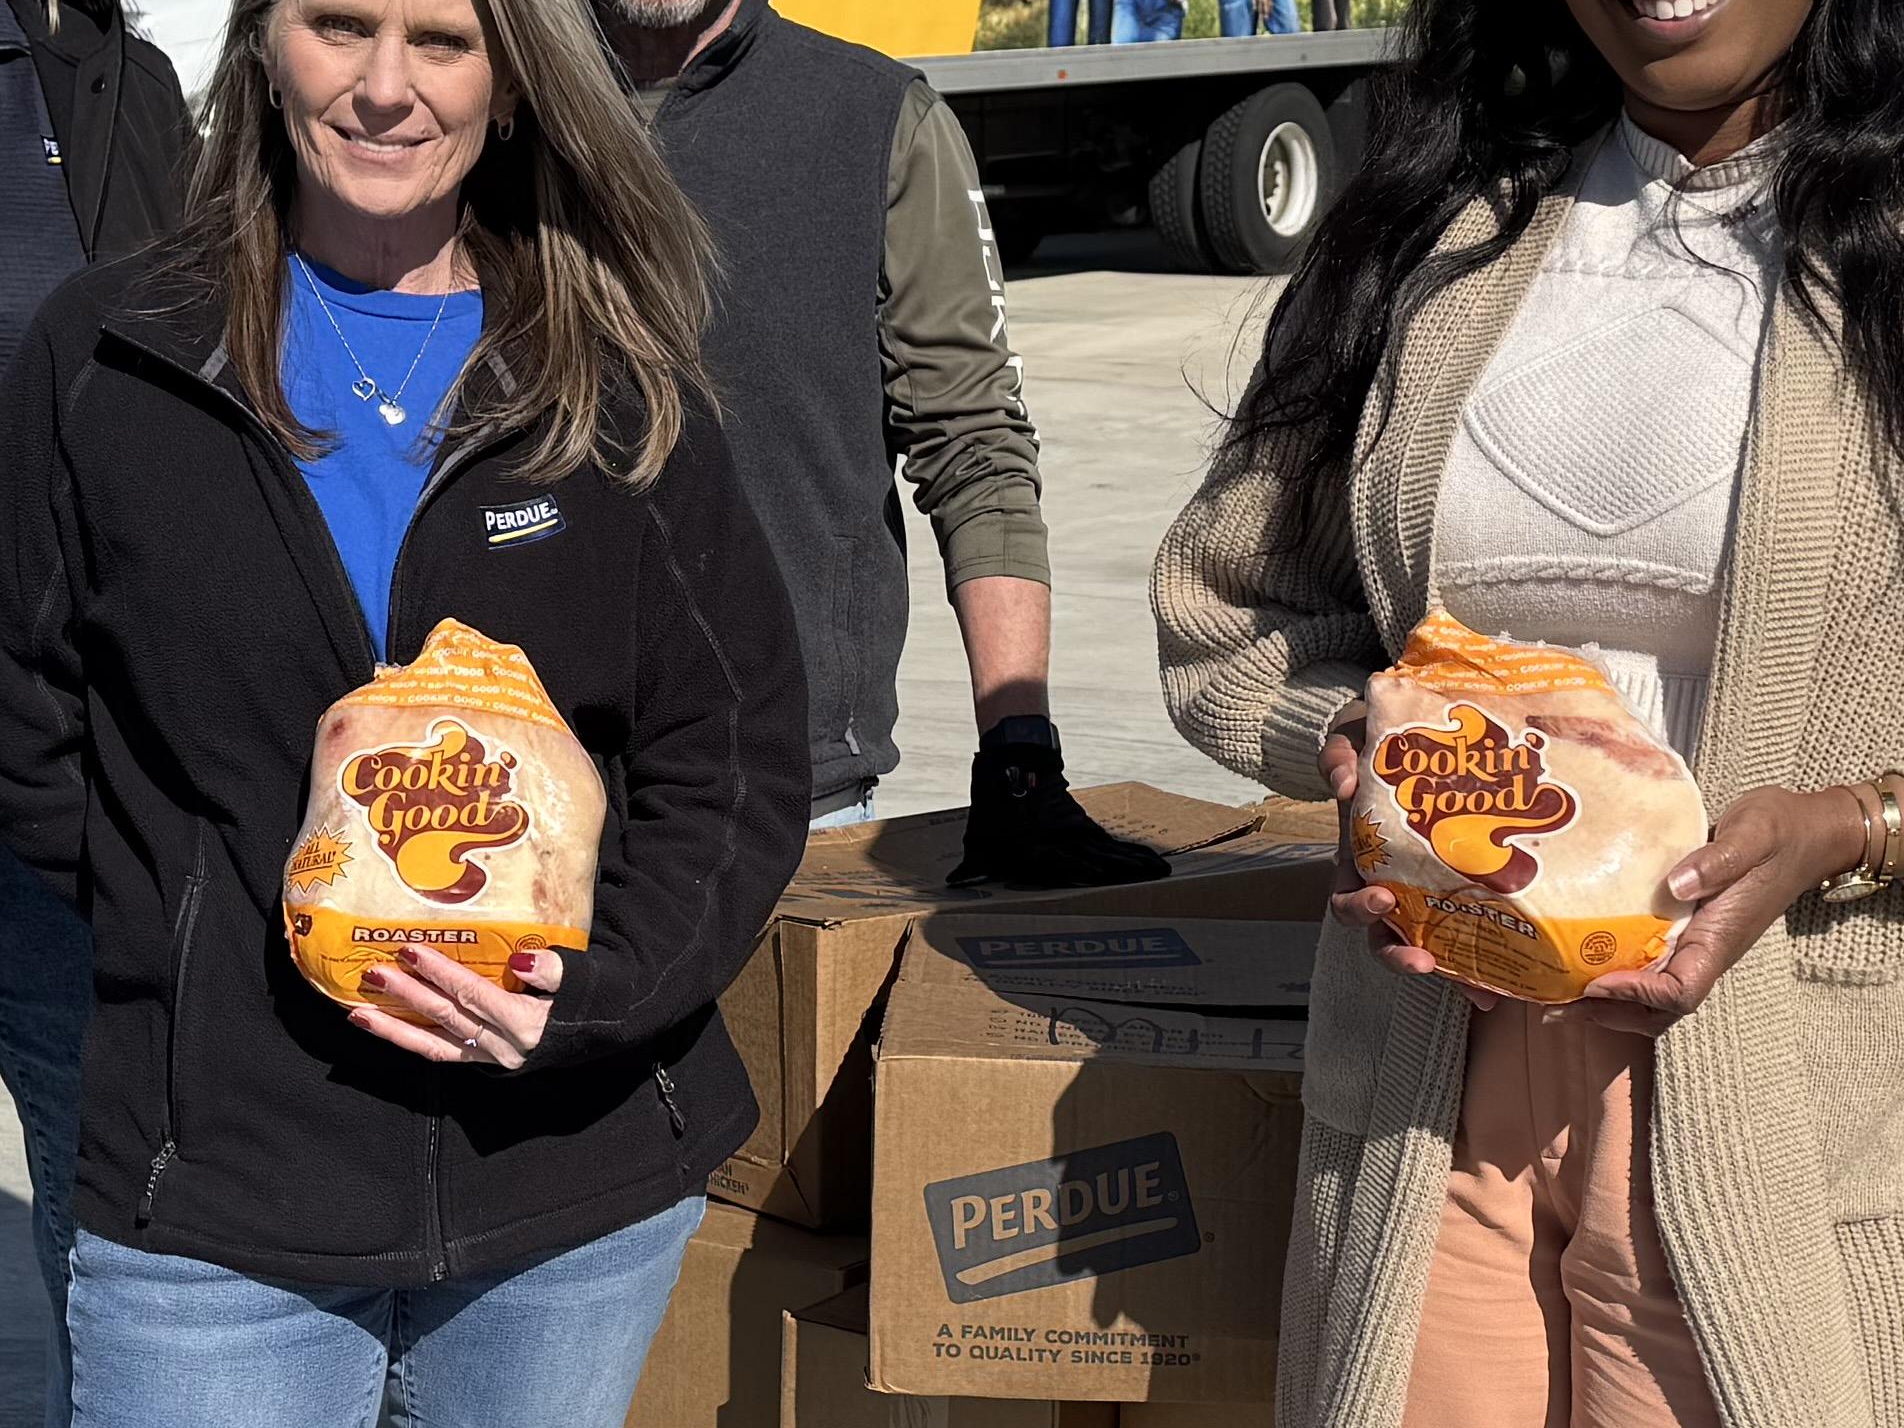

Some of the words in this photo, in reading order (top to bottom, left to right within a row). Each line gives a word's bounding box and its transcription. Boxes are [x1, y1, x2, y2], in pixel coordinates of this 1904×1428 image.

[485, 502, 551, 531] PERDUE
[342, 751, 515, 796] Cookin'
[1373, 732, 1542, 782] Cookin'
[1396, 774, 1538, 825] Good
[369, 791, 502, 846] Good
[353, 928, 478, 943] ROASTER
[979, 936, 1168, 956] PERDUE
[950, 1161, 1163, 1249] PERDUE
[932, 1343, 961, 1358] TO
[969, 1347, 1062, 1364] QUALITY
[1070, 1350, 1132, 1364] SINCE
[936, 1324, 953, 1338] A
[961, 1325, 1036, 1342] FAMILY
[1045, 1330, 1189, 1349] COMMITMENT
